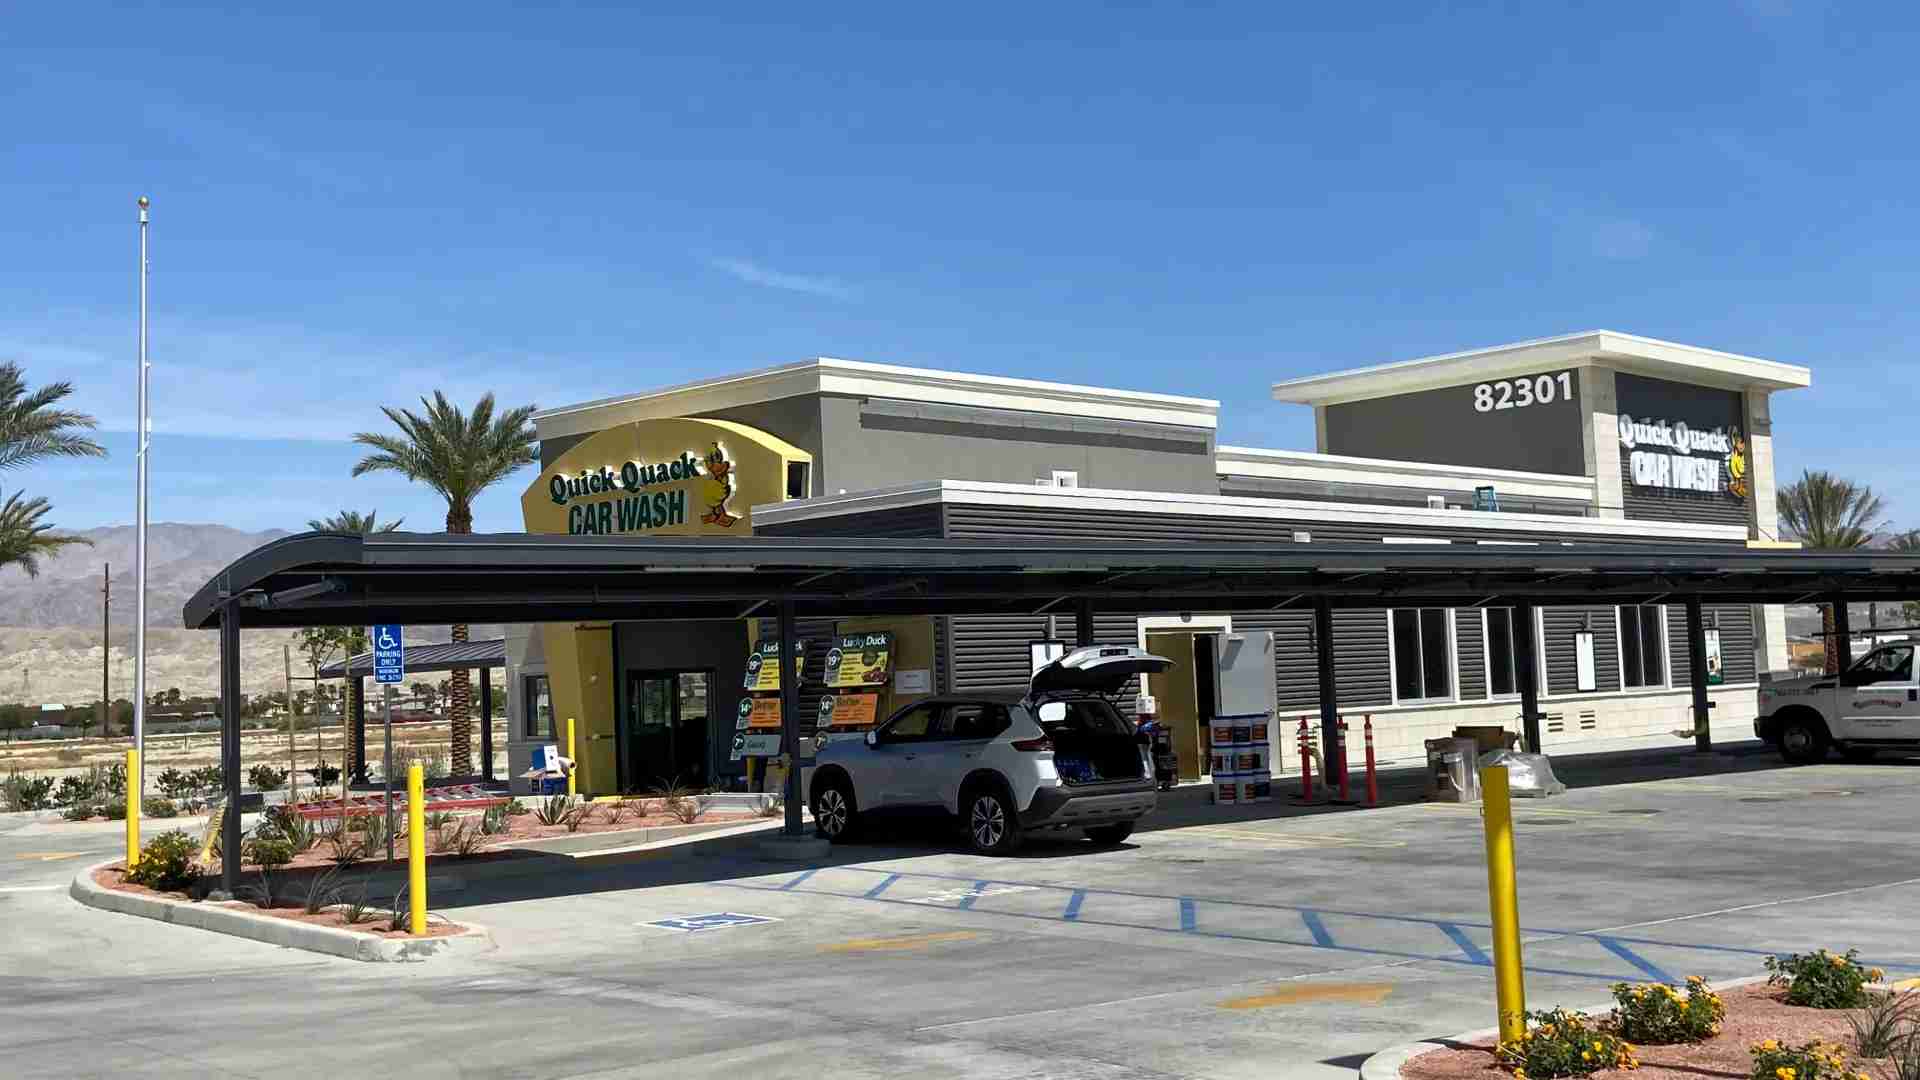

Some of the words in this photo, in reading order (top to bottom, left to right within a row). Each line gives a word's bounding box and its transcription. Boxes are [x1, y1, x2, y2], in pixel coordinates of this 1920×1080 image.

[1474, 371, 1572, 412] 82301
[1619, 414, 1673, 449] Quick
[1672, 421, 1730, 455] Quack
[550, 466, 617, 505] Quick
[621, 452, 700, 493] Quack
[1630, 450, 1670, 488] CAR
[1671, 455, 1720, 492] WASH
[568, 502, 612, 535] CAR
[617, 489, 685, 532] WASH
[843, 639, 865, 648] Lucky
[866, 635, 887, 645] Duck
